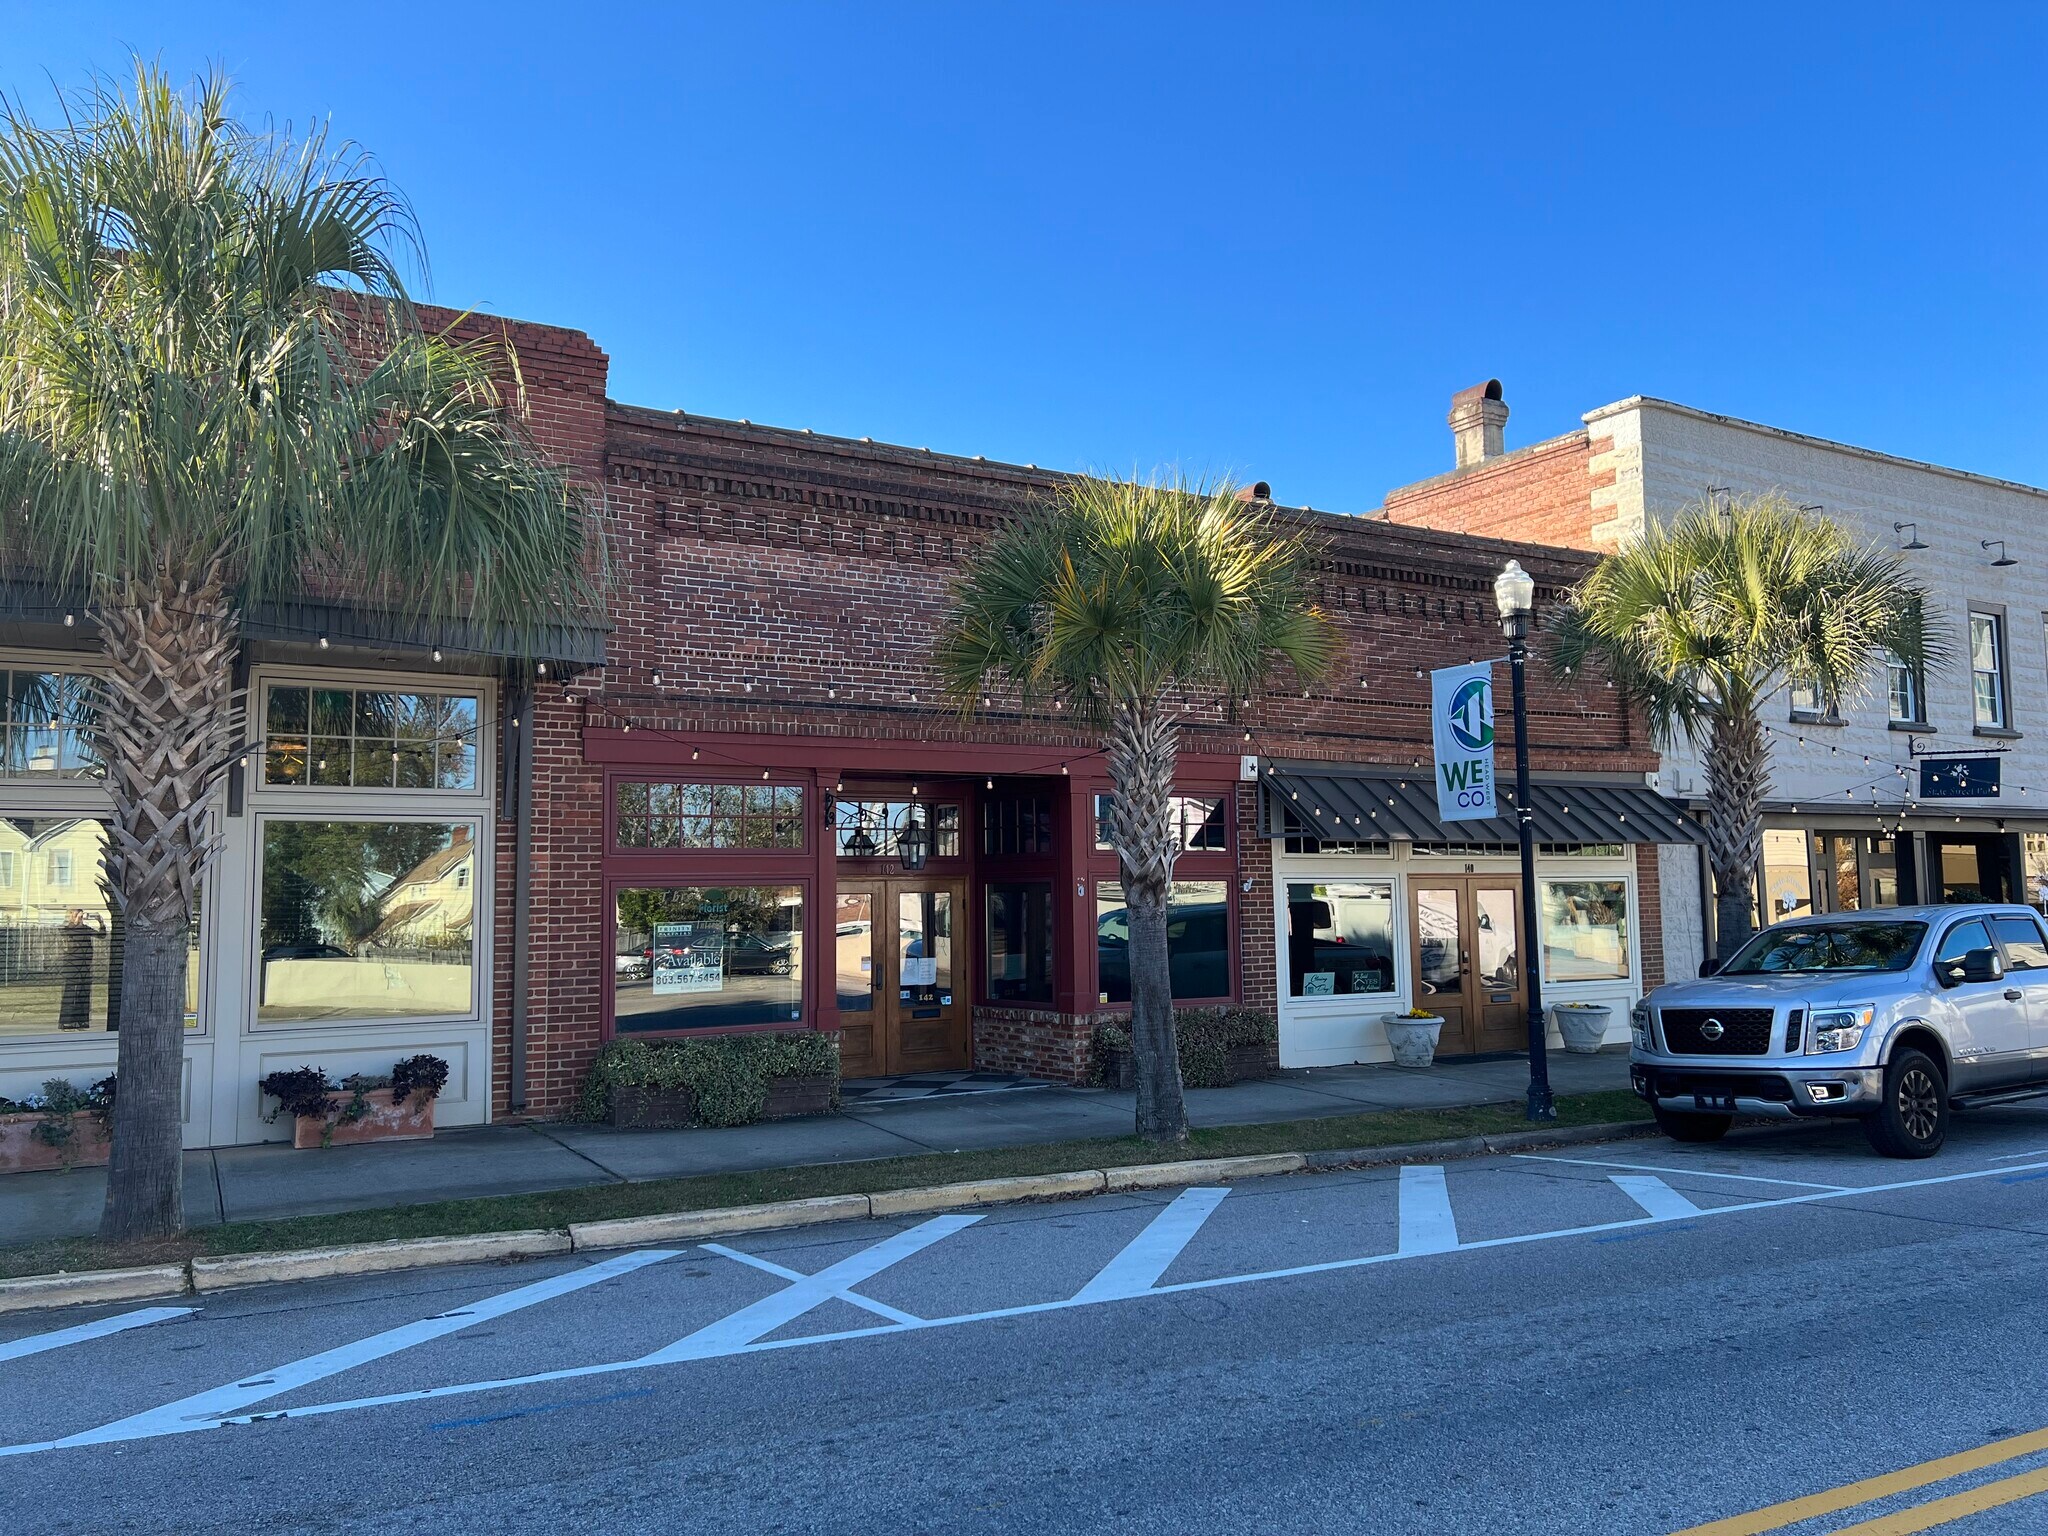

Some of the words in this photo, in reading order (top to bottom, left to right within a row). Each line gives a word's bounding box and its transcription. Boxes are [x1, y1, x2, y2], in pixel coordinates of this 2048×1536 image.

[1440, 759, 1483, 791] WE
[1458, 791, 1484, 808] CO
[1465, 863, 1474, 873] 140
[699, 902, 728, 912] Florist
[667, 952, 720, 967] Available
[656, 973, 720, 985] 803.567.5454
